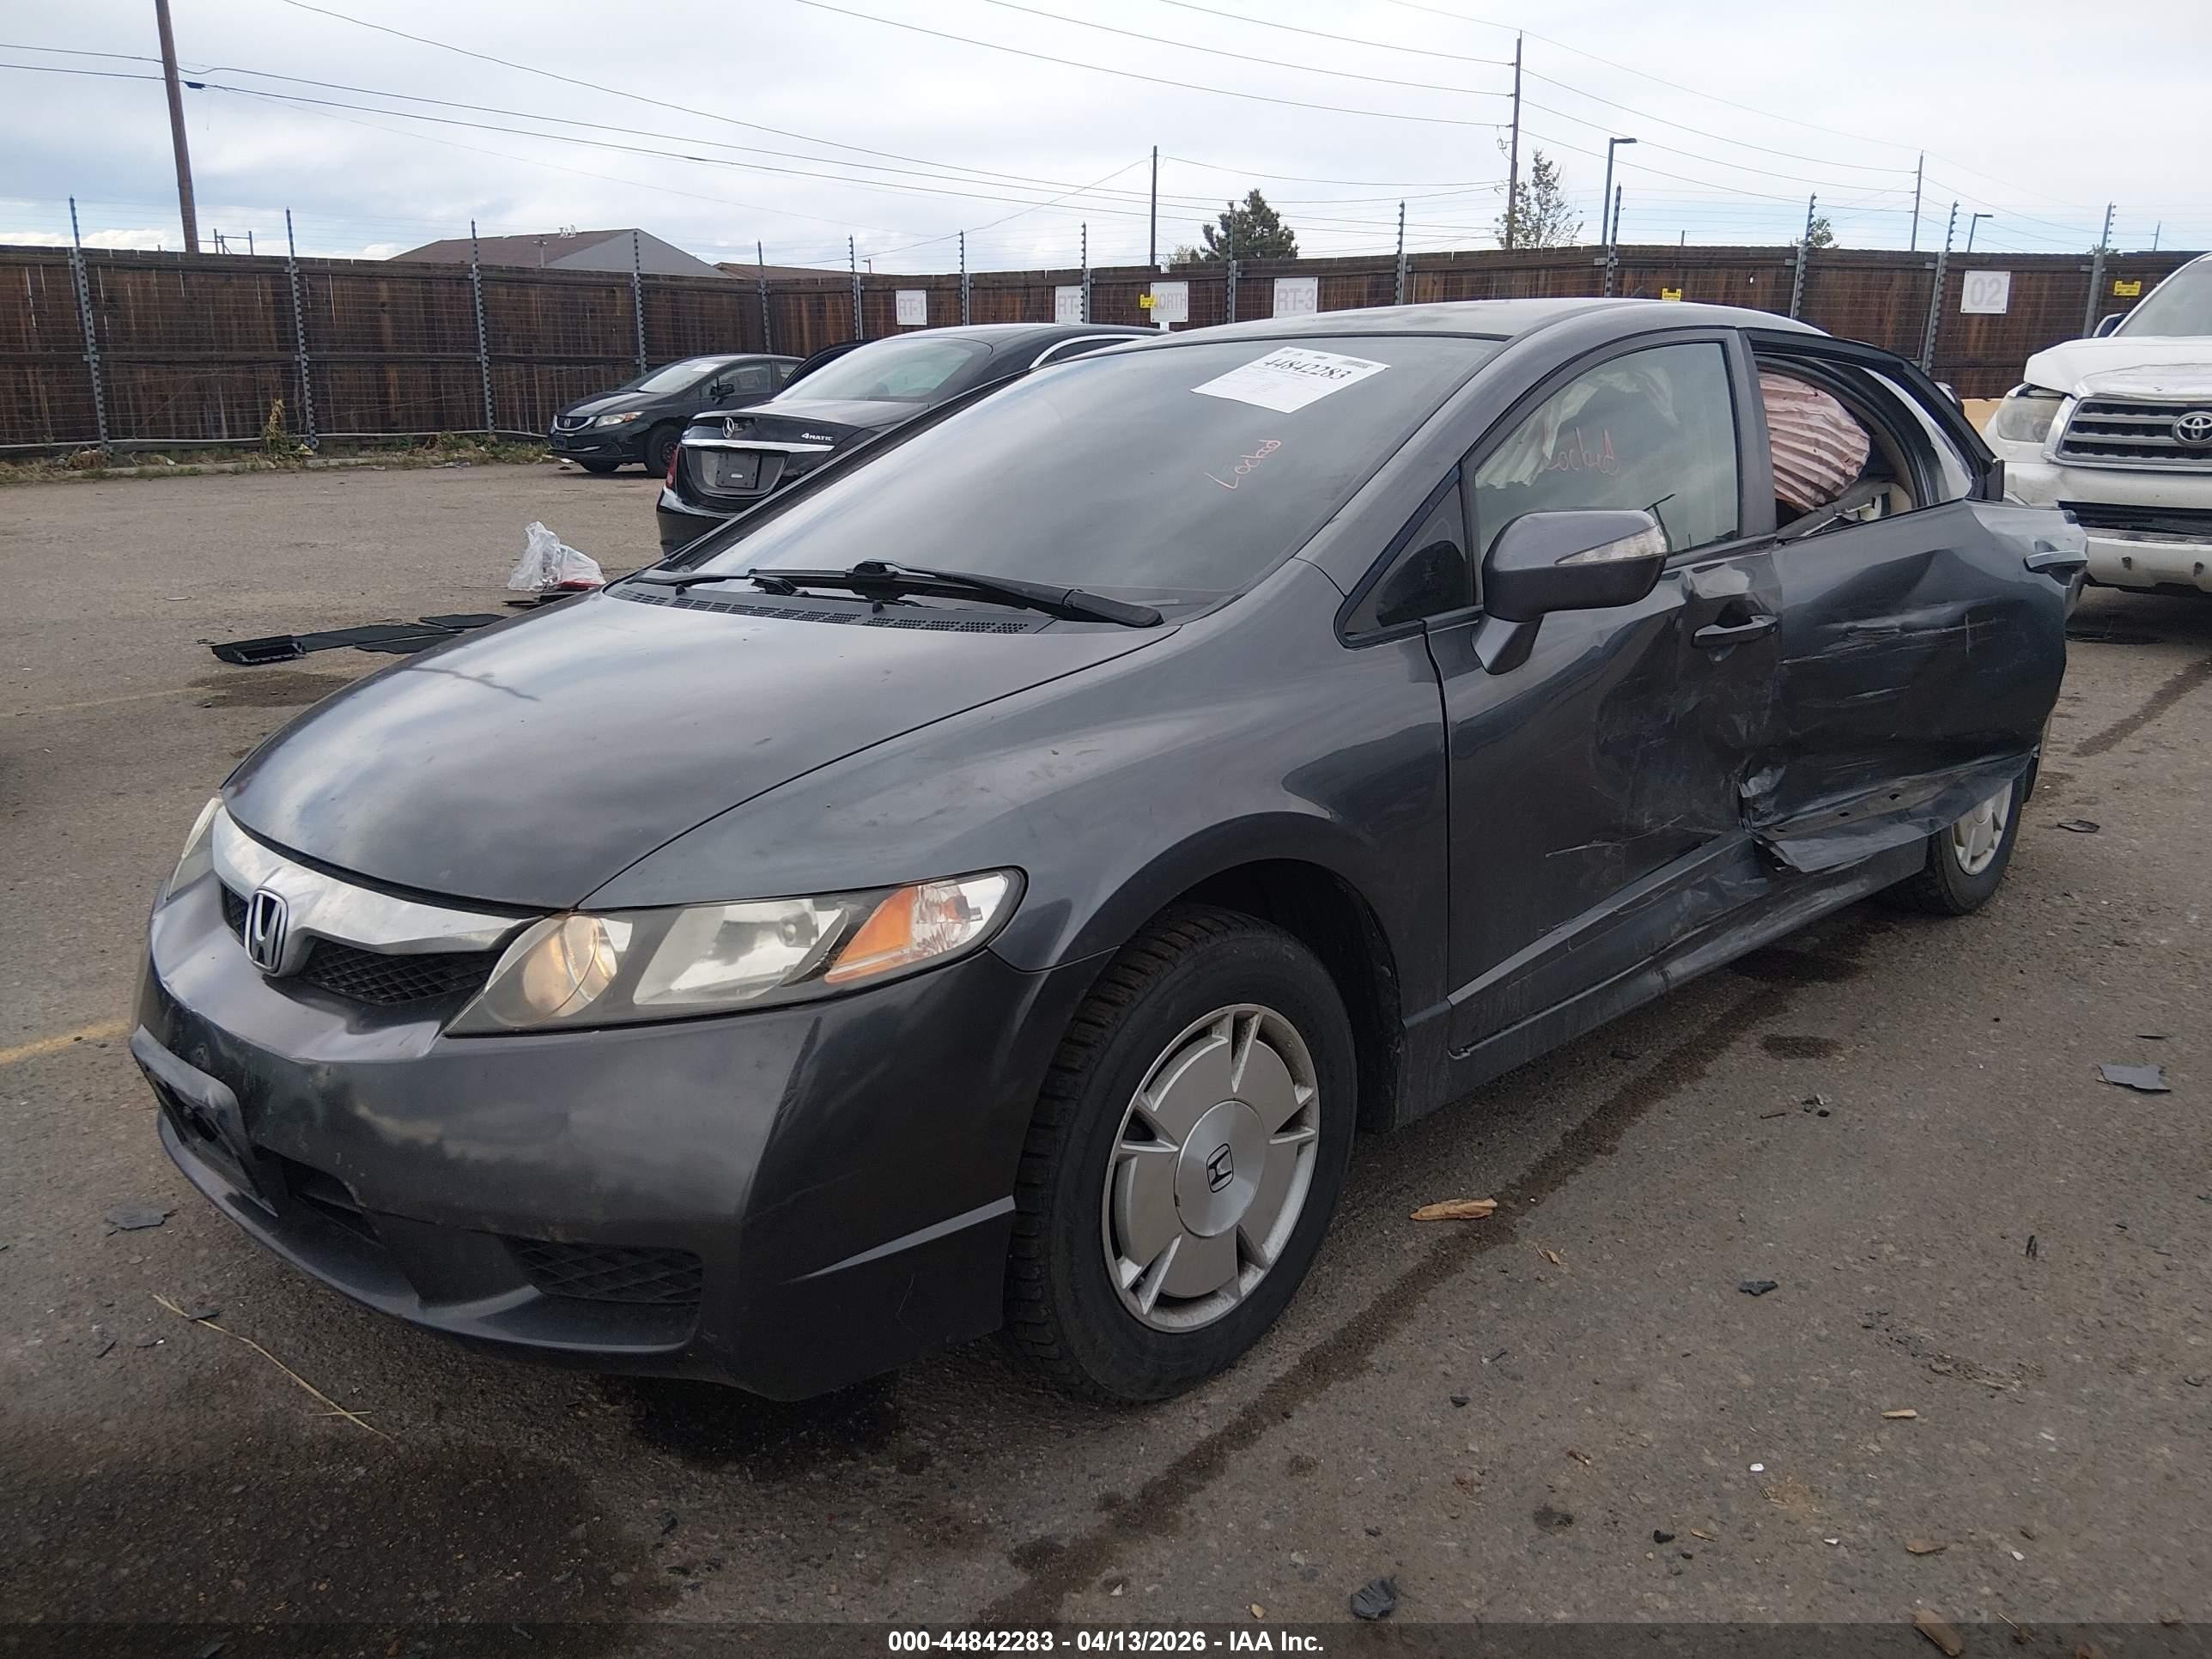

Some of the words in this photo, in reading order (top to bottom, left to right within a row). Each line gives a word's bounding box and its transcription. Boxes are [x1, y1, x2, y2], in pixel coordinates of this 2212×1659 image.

[1277, 288, 1316, 311] RT-3
[1970, 276, 2002, 307] 02
[899, 297, 924, 317] RT-1
[1057, 295, 1079, 315] RT-
[1264, 357, 1352, 380] 44842283
[800, 432, 834, 441] 4MATIC
